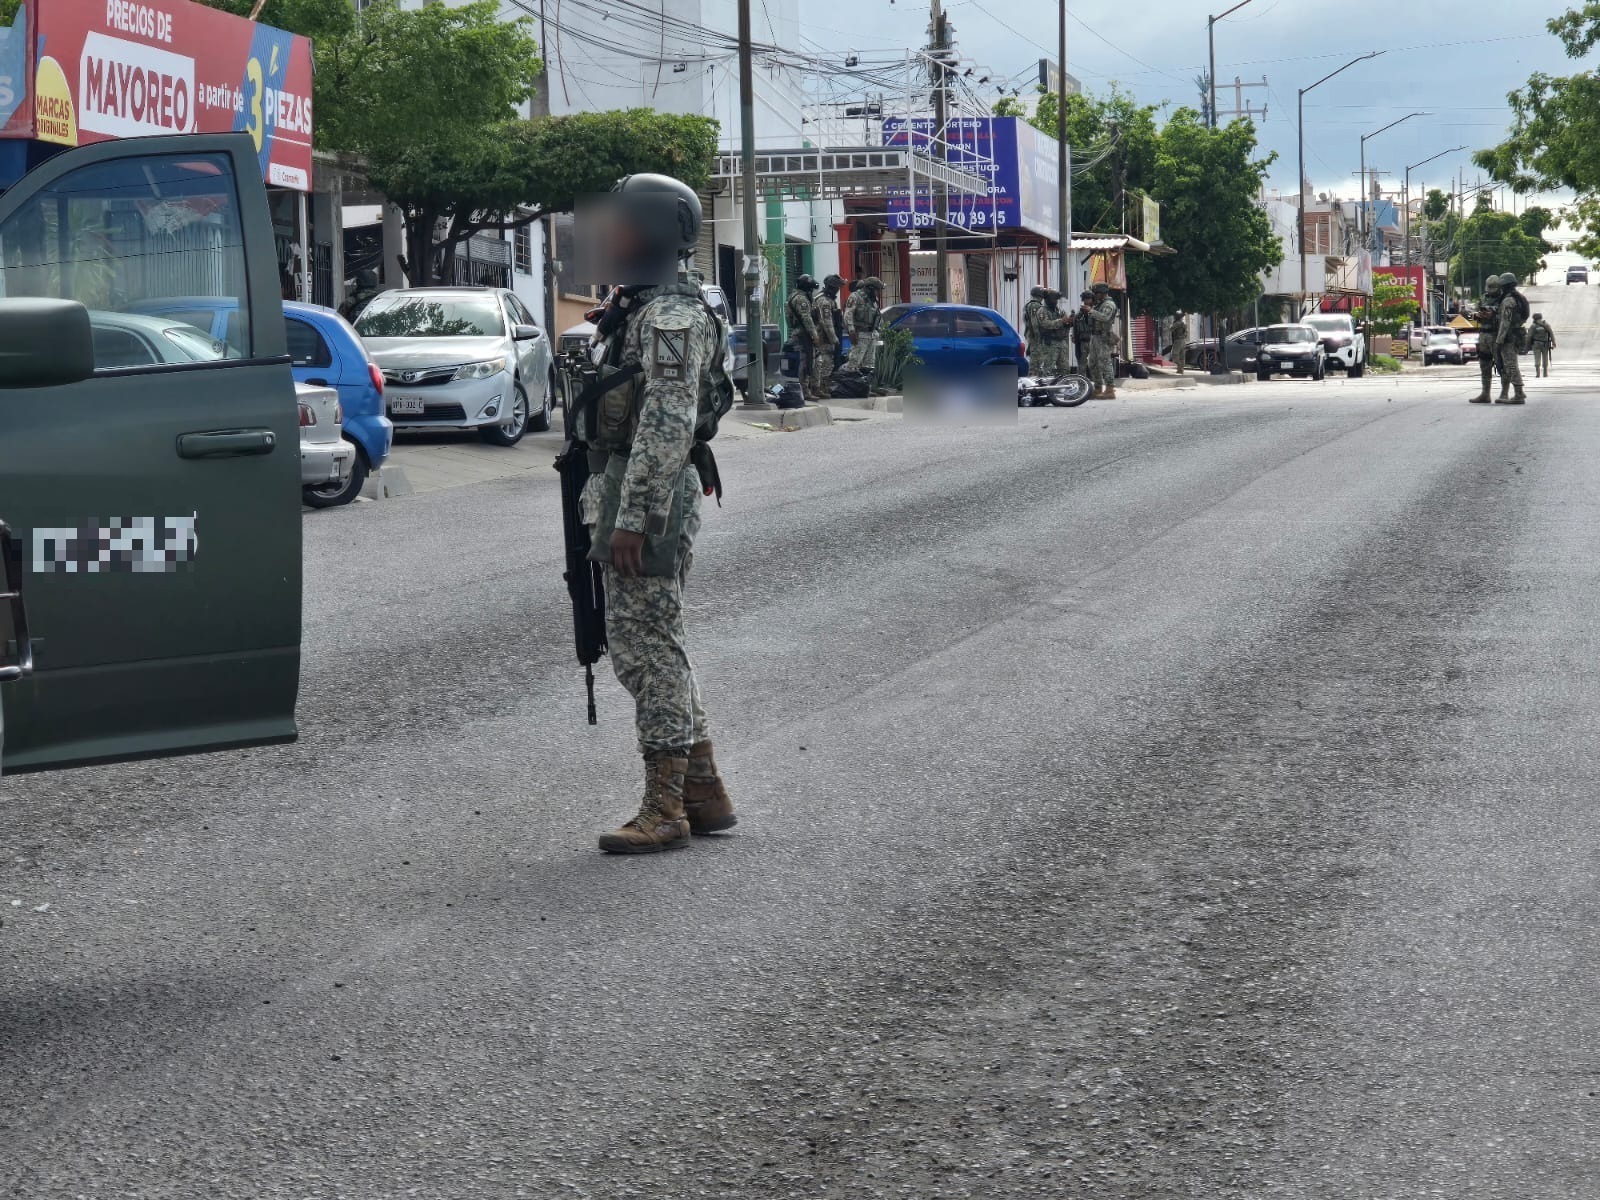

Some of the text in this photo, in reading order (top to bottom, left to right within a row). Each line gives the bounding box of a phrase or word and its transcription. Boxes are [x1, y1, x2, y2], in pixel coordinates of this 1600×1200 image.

[106, 0, 172, 43] PRECIOS DE
[36, 94, 70, 121] MARCAS
[86, 55, 189, 132] MAYOREO
[198, 82, 244, 112] a partir de
[245, 57, 312, 153] 3 PIEZAS
